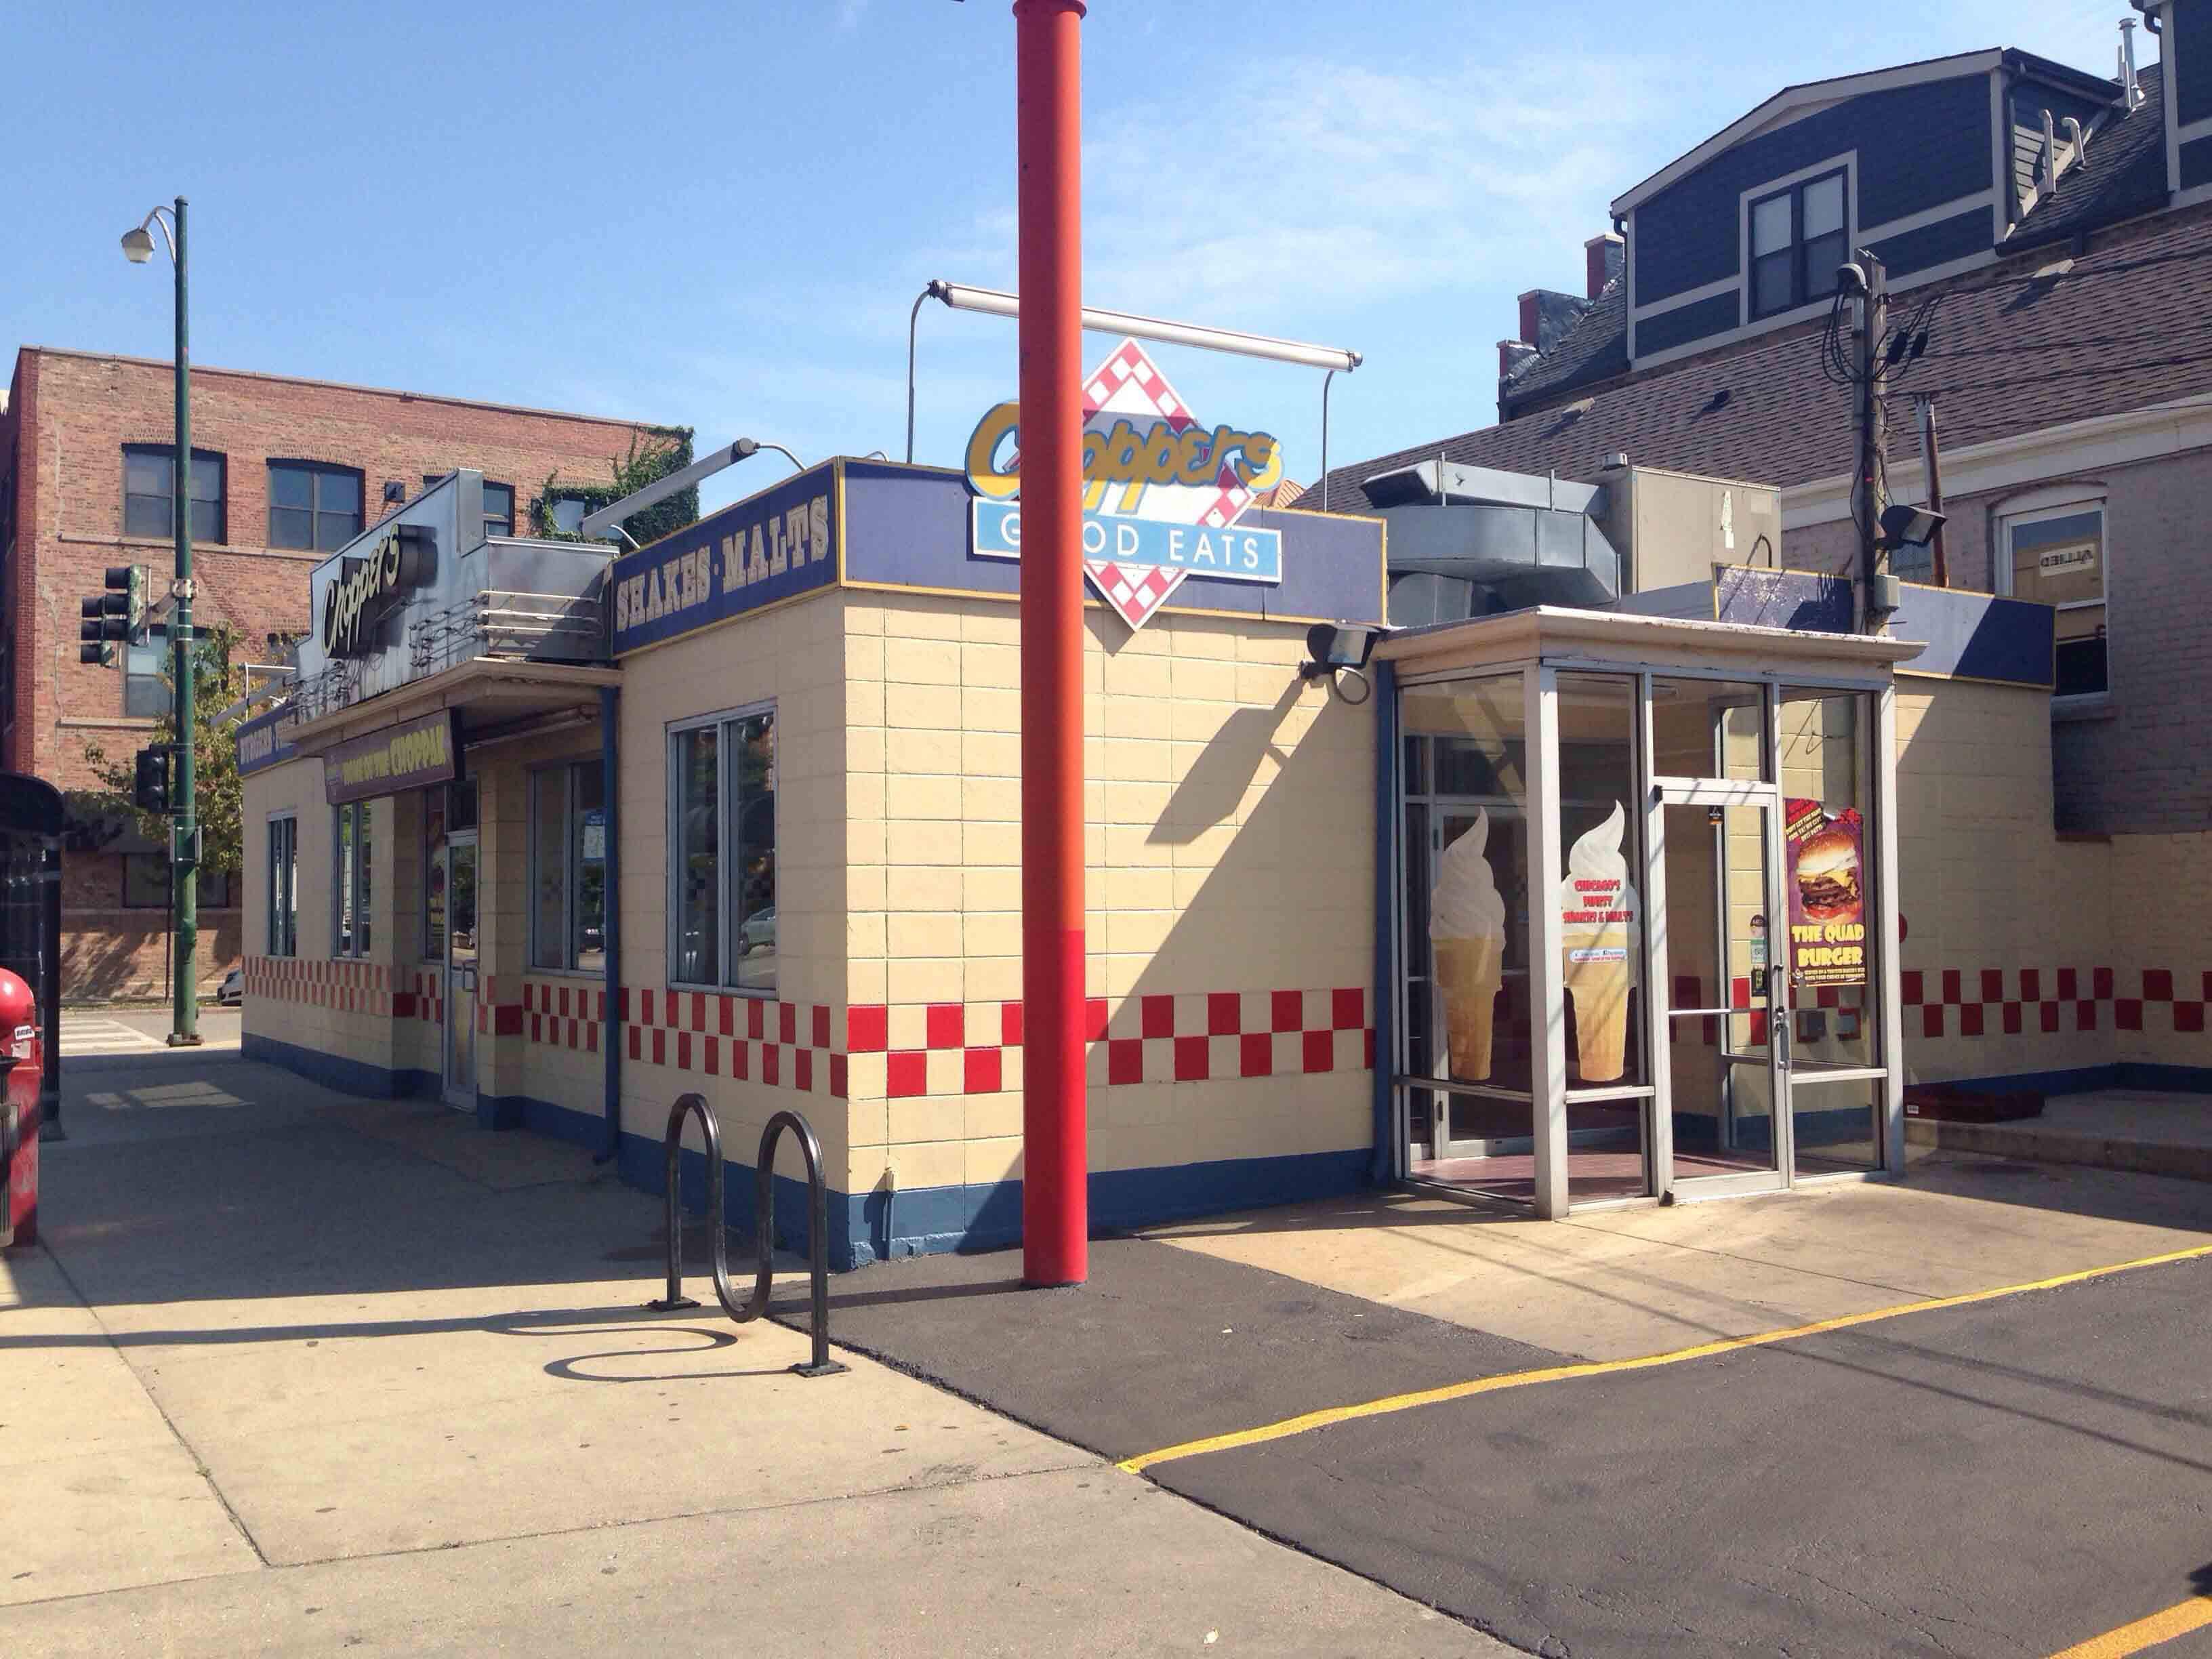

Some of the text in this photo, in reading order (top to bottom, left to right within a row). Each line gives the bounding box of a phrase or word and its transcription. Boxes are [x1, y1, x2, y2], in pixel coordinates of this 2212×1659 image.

[965, 400, 1285, 515] Coppers
[617, 494, 829, 632] SHAKES MALTS
[1001, 513, 1258, 569] GOD EATS
[1791, 923, 1864, 944] THE QUAD
[1797, 946, 1864, 967] BURGER
